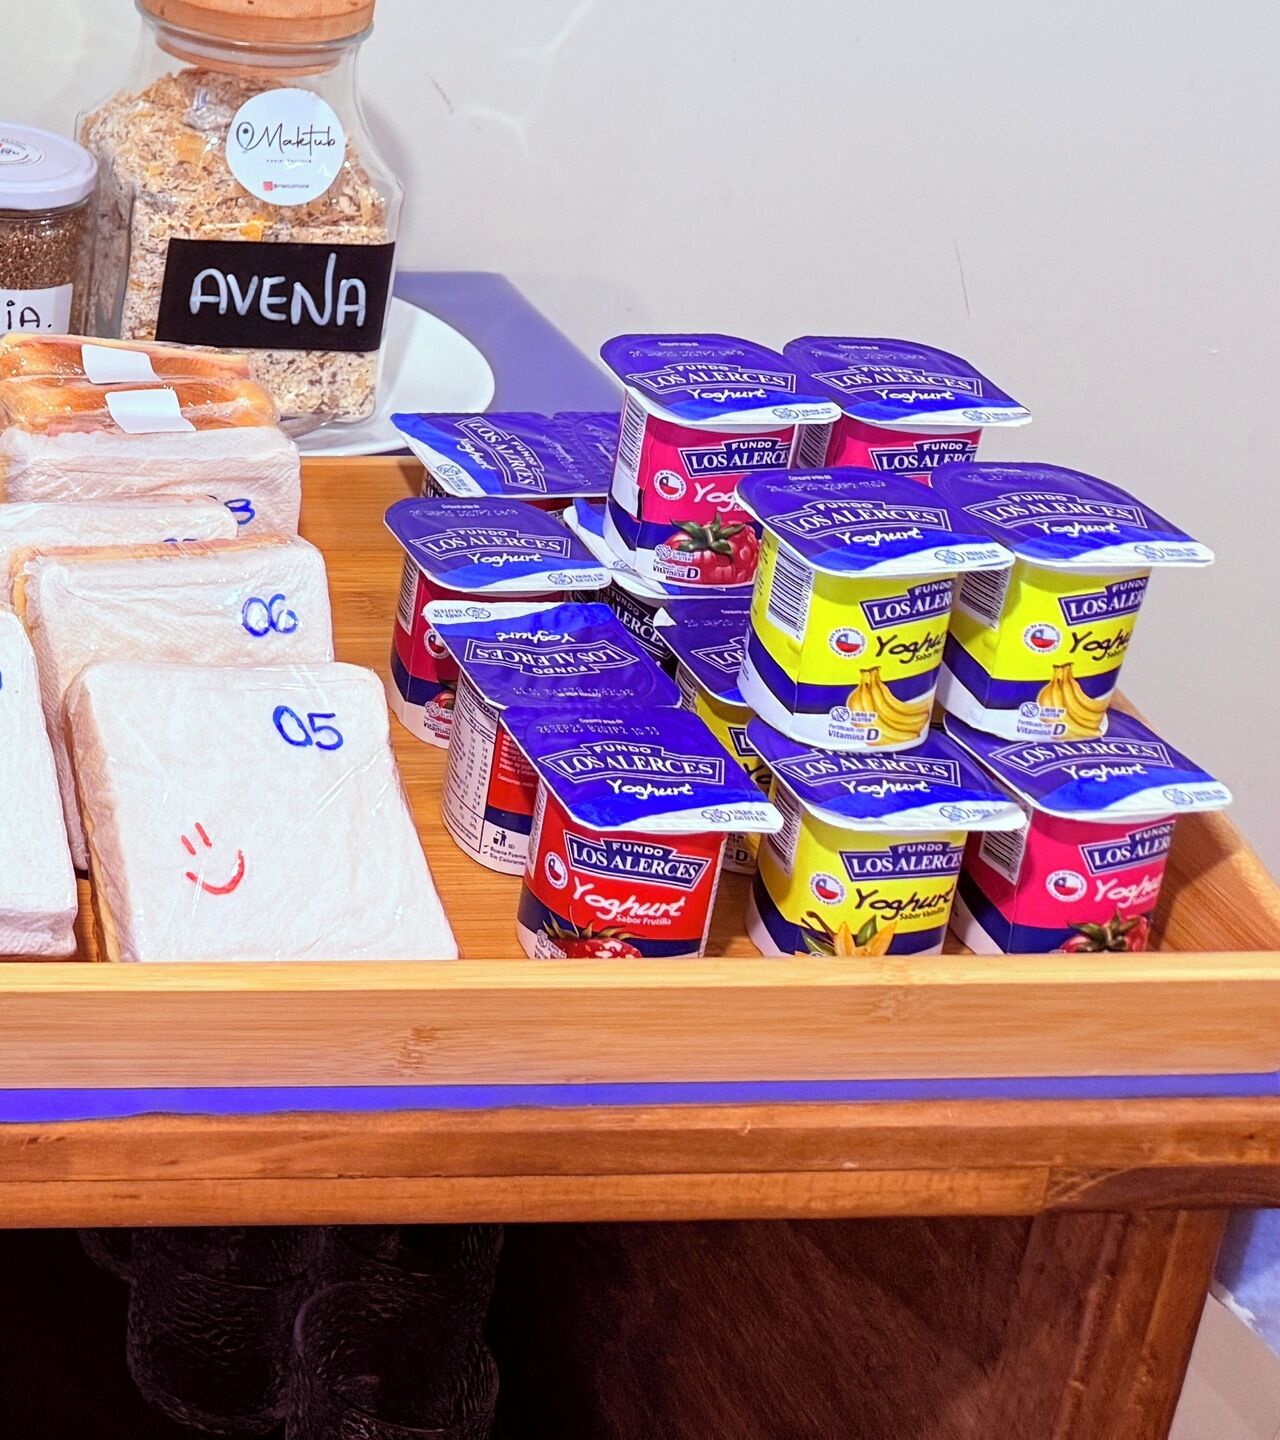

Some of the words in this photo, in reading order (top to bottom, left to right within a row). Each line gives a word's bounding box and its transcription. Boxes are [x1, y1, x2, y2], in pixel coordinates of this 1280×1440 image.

[250, 122, 336, 157] Maktub
[190, 252, 367, 328] AVENA
[676, 364, 730, 372] FUNDO
[860, 366, 915, 375] FUNDO
[645, 372, 687, 388] LOS
[688, 371, 786, 387] ALERCES
[830, 373, 873, 388] LOS
[874, 372, 972, 390] ALERCES
[686, 389, 768, 403] Yoghurt
[875, 389, 955, 403] Yoghurt
[468, 422, 502, 445] LOS
[731, 441, 772, 450] FUNDO
[923, 443, 963, 451] FUNDO
[691, 454, 728, 470] LOS
[882, 456, 919, 471] LOS
[816, 501, 873, 510] FUNDO
[1011, 494, 1068, 502] FUNDO
[983, 504, 1028, 521] LOS
[1029, 501, 1134, 520] ALERCES
[793, 511, 840, 532] LOS
[840, 509, 939, 525] ALERCES
[458, 529, 508, 537] FUNDO
[836, 527, 924, 547] Yoghurt
[1034, 522, 1121, 538] Yoghurt
[426, 534, 468, 553] LOS
[469, 535, 562, 552] ALERCES
[466, 552, 544, 568] Yoghurt
[686, 567, 700, 579] D
[914, 581, 952, 596] FUNDO
[872, 601, 911, 621] LOS
[1069, 597, 1108, 617] LOS
[241, 593, 299, 638] 06
[496, 630, 576, 644] Yoghurt
[476, 648, 575, 665] ALERCES
[577, 648, 620, 662] LOS
[532, 665, 588, 674] FUNDO
[273, 705, 345, 752] 05
[828, 729, 865, 741] Vitamina
[866, 728, 880, 741] D
[1053, 723, 1066, 736] D
[592, 744, 652, 754] FUNDO
[1008, 745, 1055, 768] LOS
[1057, 741, 1161, 760] ALERCES
[558, 755, 605, 774] LOS
[606, 754, 715, 775] ALERCES
[796, 759, 842, 779] LOS
[842, 757, 949, 777] ALERCES
[1061, 763, 1149, 781] Yoghurt
[606, 778, 694, 800] Yoghurt
[840, 780, 932, 798] Yoghurt
[612, 842, 664, 857] FUNDO
[897, 843, 943, 854] FUNDO
[1092, 845, 1131, 867] LOS
[572, 842, 608, 866] LOS
[609, 855, 699, 880] ALERCES
[851, 857, 893, 874] LOS
[573, 876, 687, 921] Yoghurt
[616, 914, 642, 926] Sabor
[642, 916, 672, 926] Frutilla
